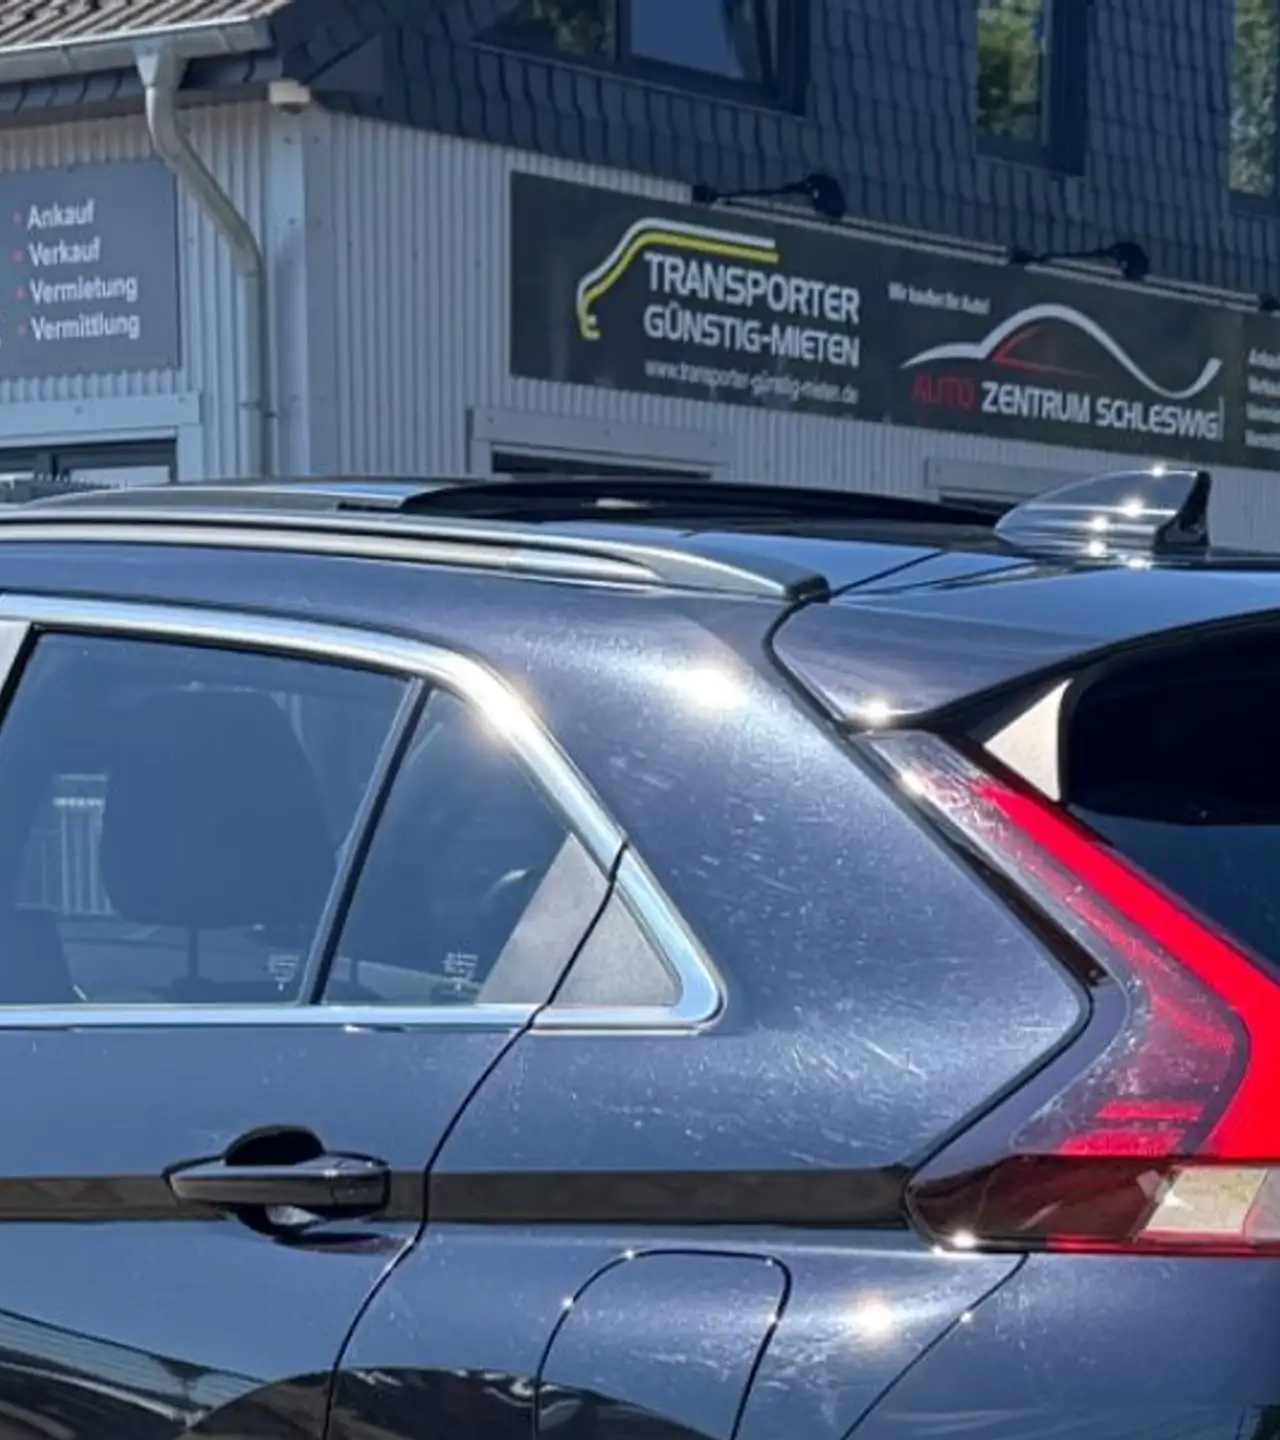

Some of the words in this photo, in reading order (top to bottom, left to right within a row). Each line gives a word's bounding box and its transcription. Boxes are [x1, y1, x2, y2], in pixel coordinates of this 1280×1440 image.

[27, 199, 95, 230] Ankauf
[28, 237, 101, 266] Verkauf
[30, 276, 138, 306] Vermietung
[643, 251, 860, 325] TRANSPORTER
[31, 312, 141, 341] Vermittlung
[643, 300, 860, 369] GÜNSTIG-MIETEN
[980, 381, 1091, 427] ZENTRUM
[1095, 396, 1219, 439] SCHLESWIG
